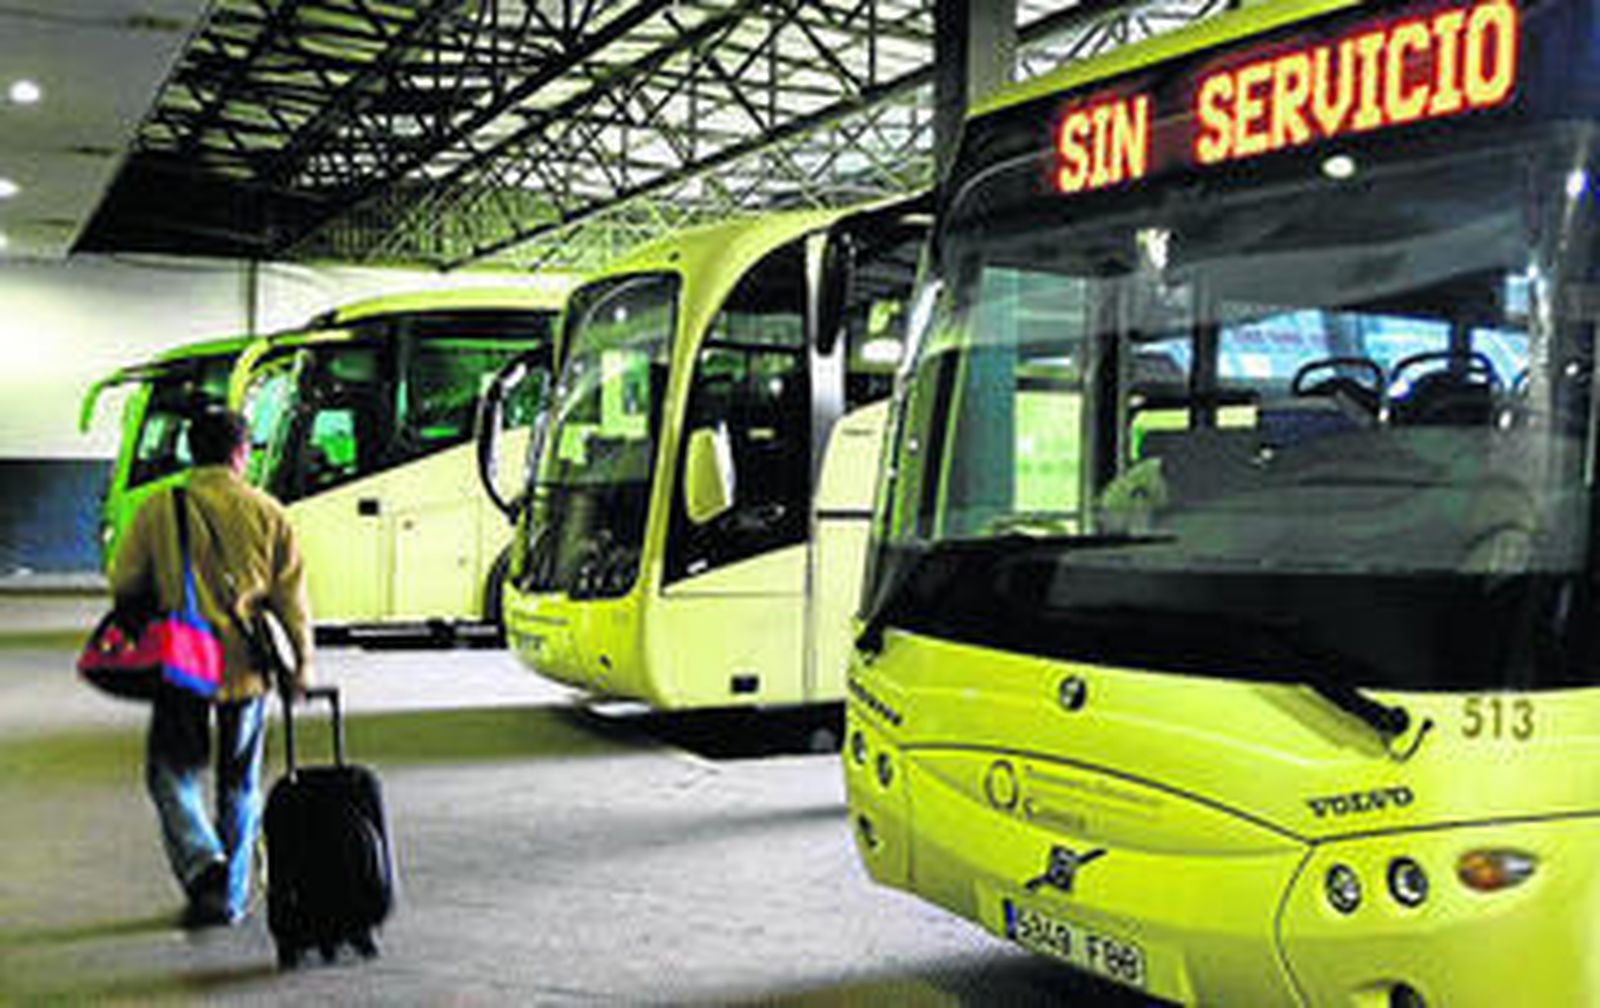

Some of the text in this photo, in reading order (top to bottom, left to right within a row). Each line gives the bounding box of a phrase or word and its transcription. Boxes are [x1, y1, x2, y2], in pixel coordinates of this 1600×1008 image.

[1056, 2, 1517, 193] SIN SERVICIO
[1461, 697, 1535, 741] 513
[1307, 786, 1414, 818] VOLVO
